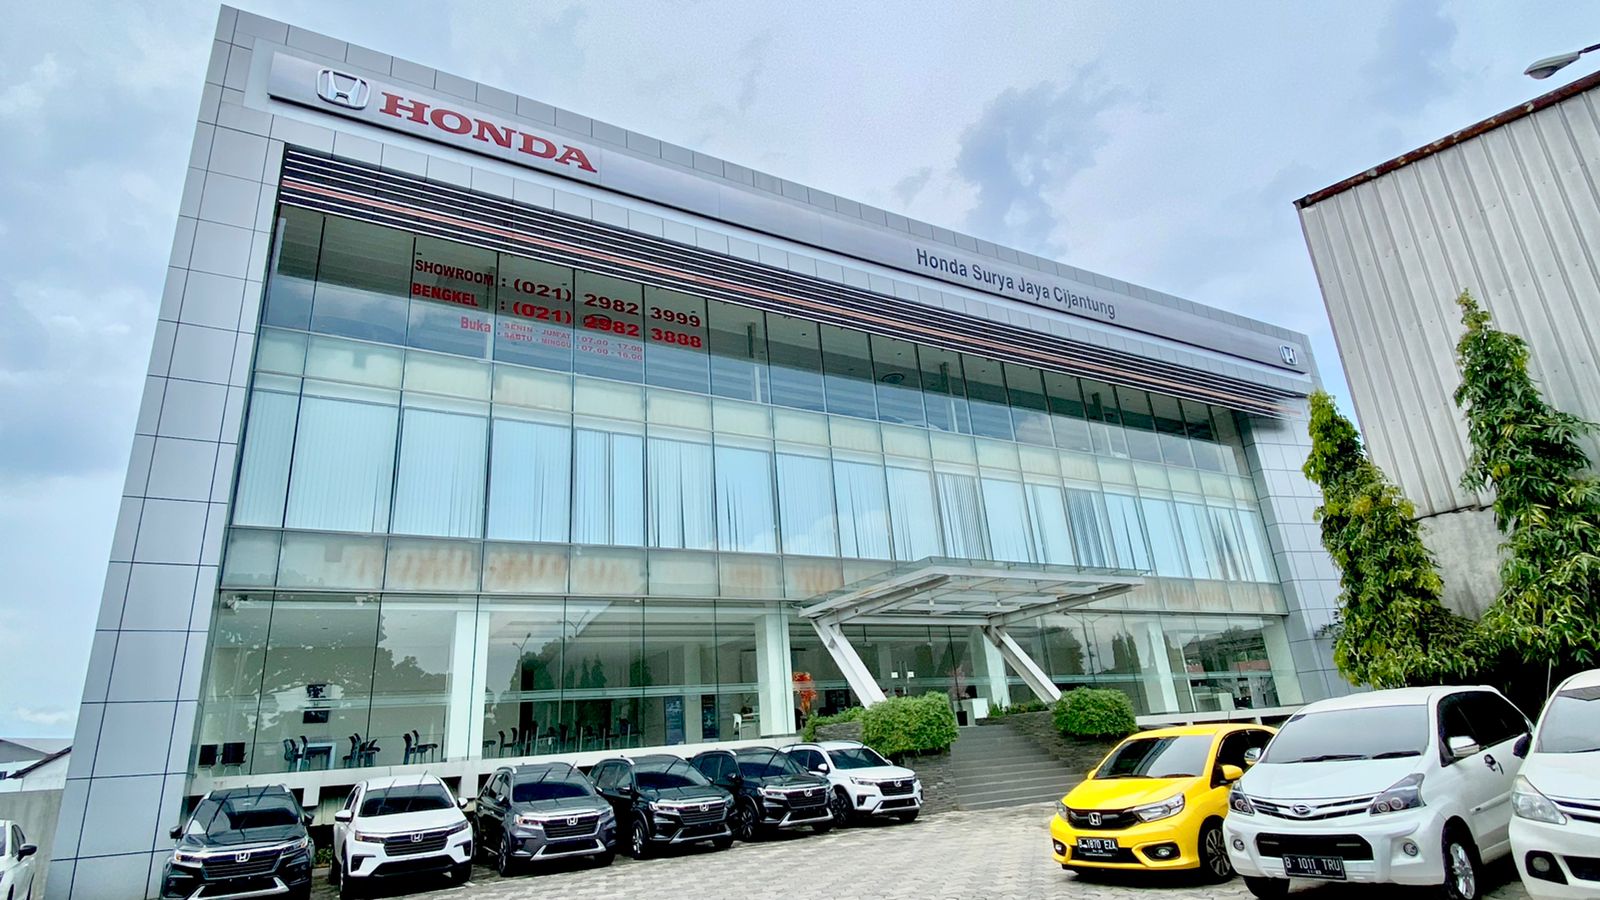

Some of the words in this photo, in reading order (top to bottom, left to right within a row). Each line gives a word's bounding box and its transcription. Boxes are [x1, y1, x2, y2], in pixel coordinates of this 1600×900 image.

[379, 92, 598, 173] HONDA
[415, 259, 494, 286] SHOWROOM
[514, 279, 572, 302] (021)
[584, 293, 639, 316] 2982
[650, 307, 701, 327] 3999
[916, 248, 967, 277] Honda
[973, 264, 1014, 290] Surya
[1018, 277, 1050, 300] Jaya
[1053, 286, 1115, 319] Cijantung
[412, 282, 478, 306] BENGKEL
[513, 302, 572, 324] (021)
[583, 315, 640, 337] 2982
[650, 328, 702, 348] 3888
[461, 316, 491, 332] Buka
[504, 323, 533, 333] SENIN
[504, 332, 533, 342] SABTU
[1284, 857, 1292, 868] B
[1298, 858, 1316, 869] 1011
[1321, 858, 1341, 870] TRU
